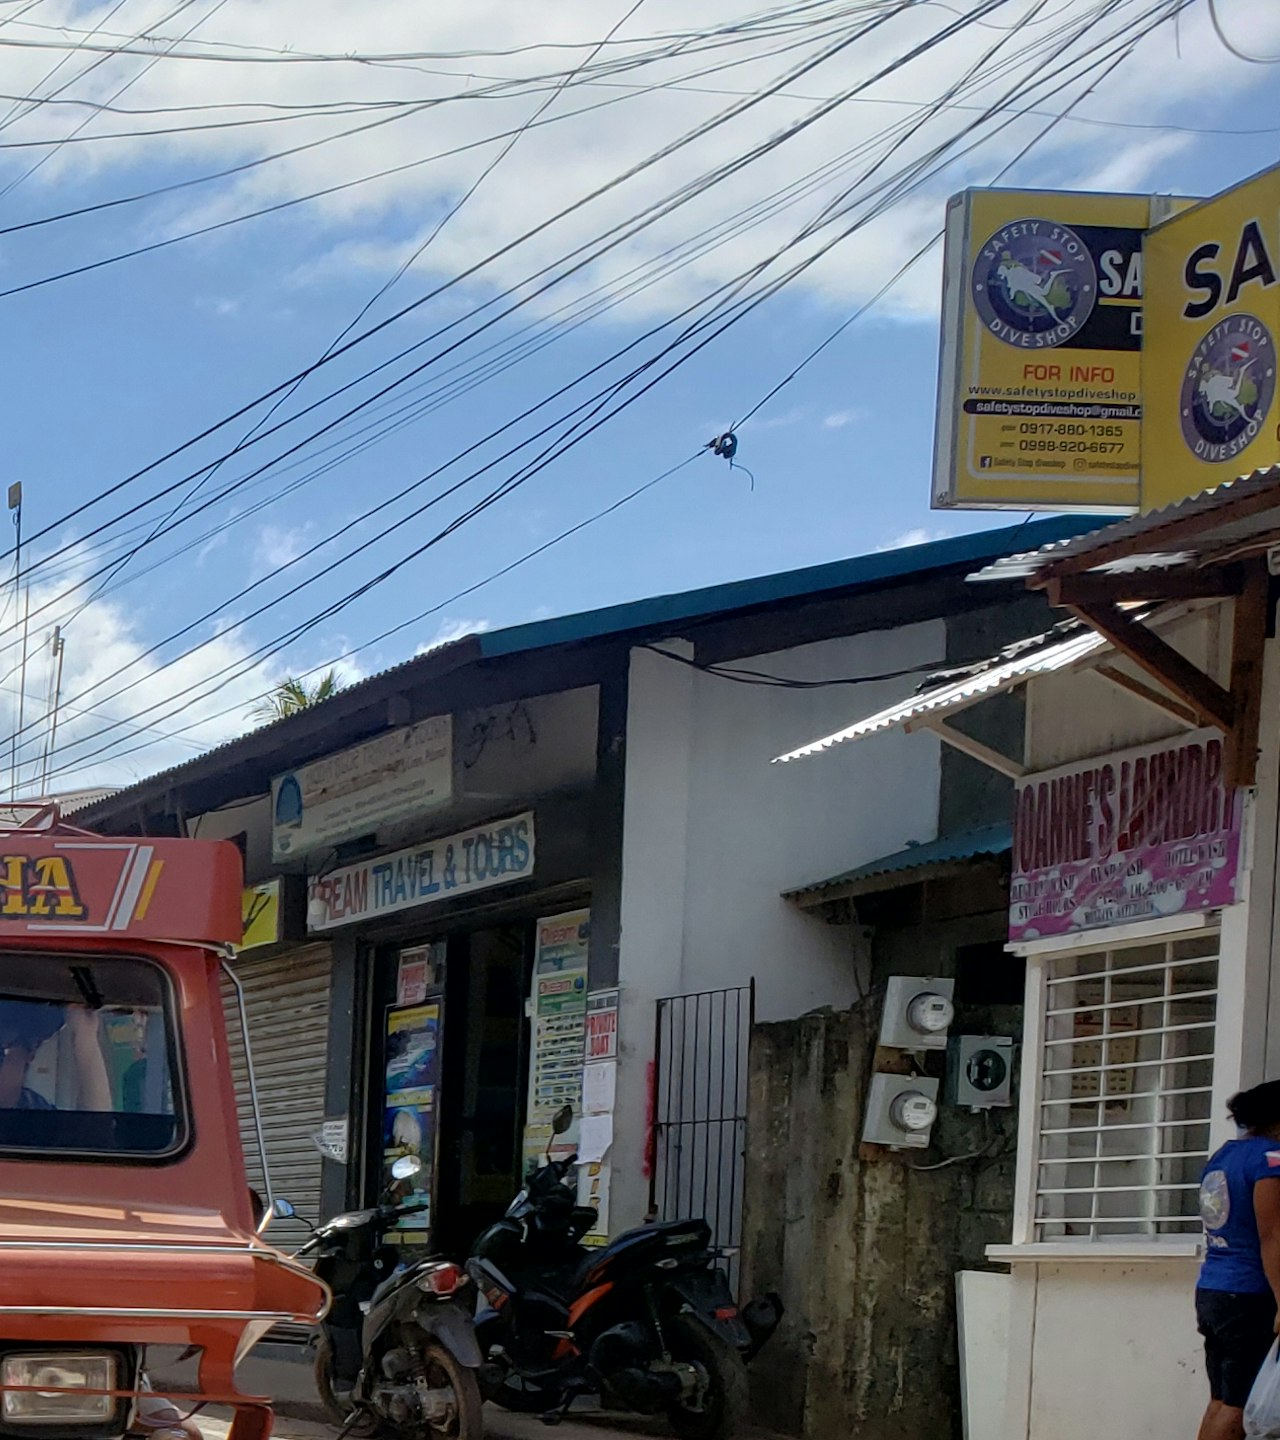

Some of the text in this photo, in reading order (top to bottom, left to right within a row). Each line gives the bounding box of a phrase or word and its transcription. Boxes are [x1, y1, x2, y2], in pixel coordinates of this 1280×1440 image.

[984, 223, 1085, 262] SAFETY STOP
[989, 316, 1078, 347] DIVE SHOP
[1188, 318, 1268, 379] SAFETY STOP
[1023, 364, 1115, 383] FOR INFO
[968, 385, 1136, 403] www.safetystopdiveshop
[1019, 423, 1123, 437] 0917-880-1365
[1194, 408, 1264, 460] DIVE SHOP
[1019, 440, 1124, 454] 0998-920-6677
[371, 850, 440, 909] TRAVEL
[443, 843, 458, 890] &
[462, 819, 531, 884] TOURS
